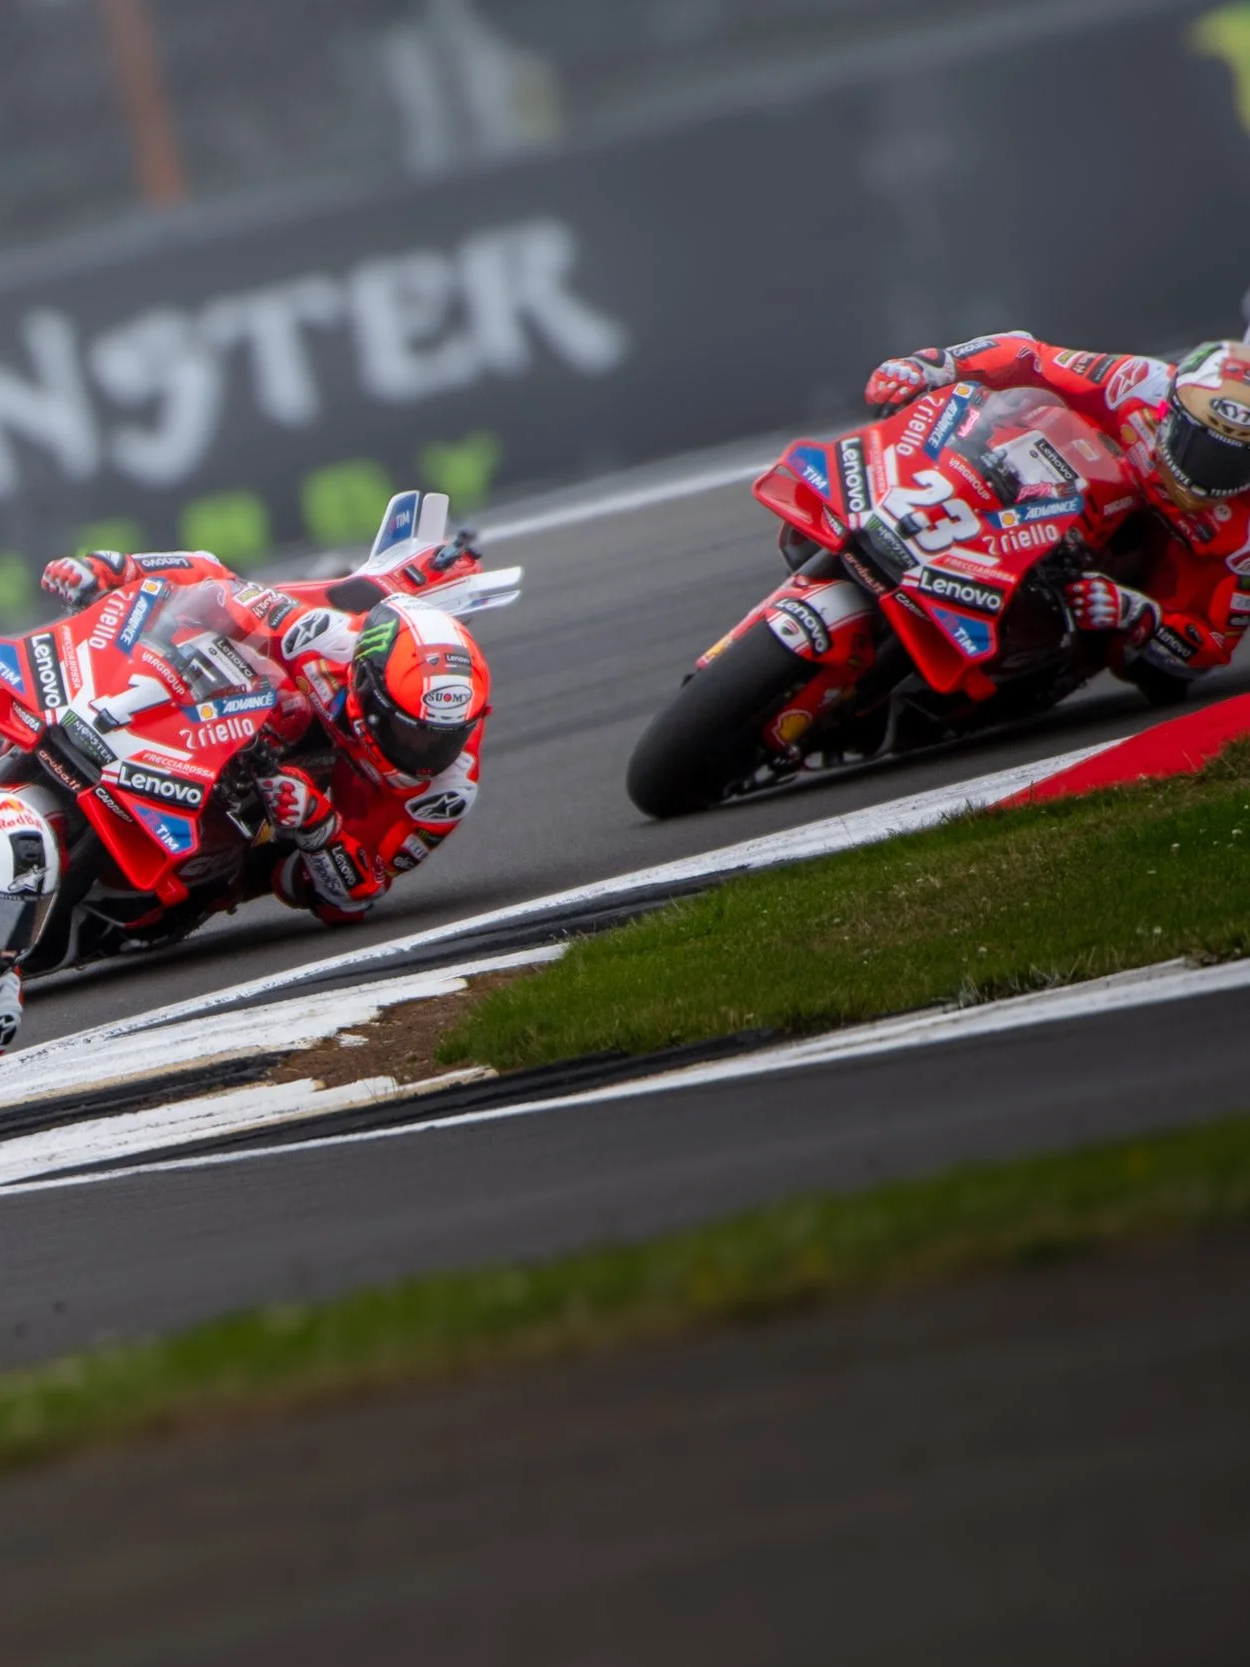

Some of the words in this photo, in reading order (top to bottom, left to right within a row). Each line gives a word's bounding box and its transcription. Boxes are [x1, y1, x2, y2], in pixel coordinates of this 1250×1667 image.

[802, 466, 828, 490] TIM
[840, 437, 865, 512] Lenovo
[949, 457, 991, 500] VARGROUP
[1039, 441, 1073, 479] Lenovo
[396, 510, 410, 529] TIM
[883, 469, 981, 551] 23
[1000, 523, 1060, 554] riello
[844, 552, 886, 594] aruba.it
[920, 570, 1001, 610] Lenovo
[89, 598, 125, 650] riello
[775, 598, 829, 653] Lenovo
[953, 626, 978, 655] TIM
[31, 633, 61, 708] Lenovo
[141, 651, 185, 696] VARGROUP
[217, 639, 255, 677] Lenovo
[88, 673, 171, 728] 1
[427, 690, 470, 705] SUOMY
[72, 719, 113, 764] MONSTER
[197, 717, 255, 748] riello
[38, 749, 82, 791] aruba.it
[118, 765, 202, 804] Lenovo
[142, 752, 215, 779] FRECCIAROSSA
[155, 823, 180, 851] TIM
